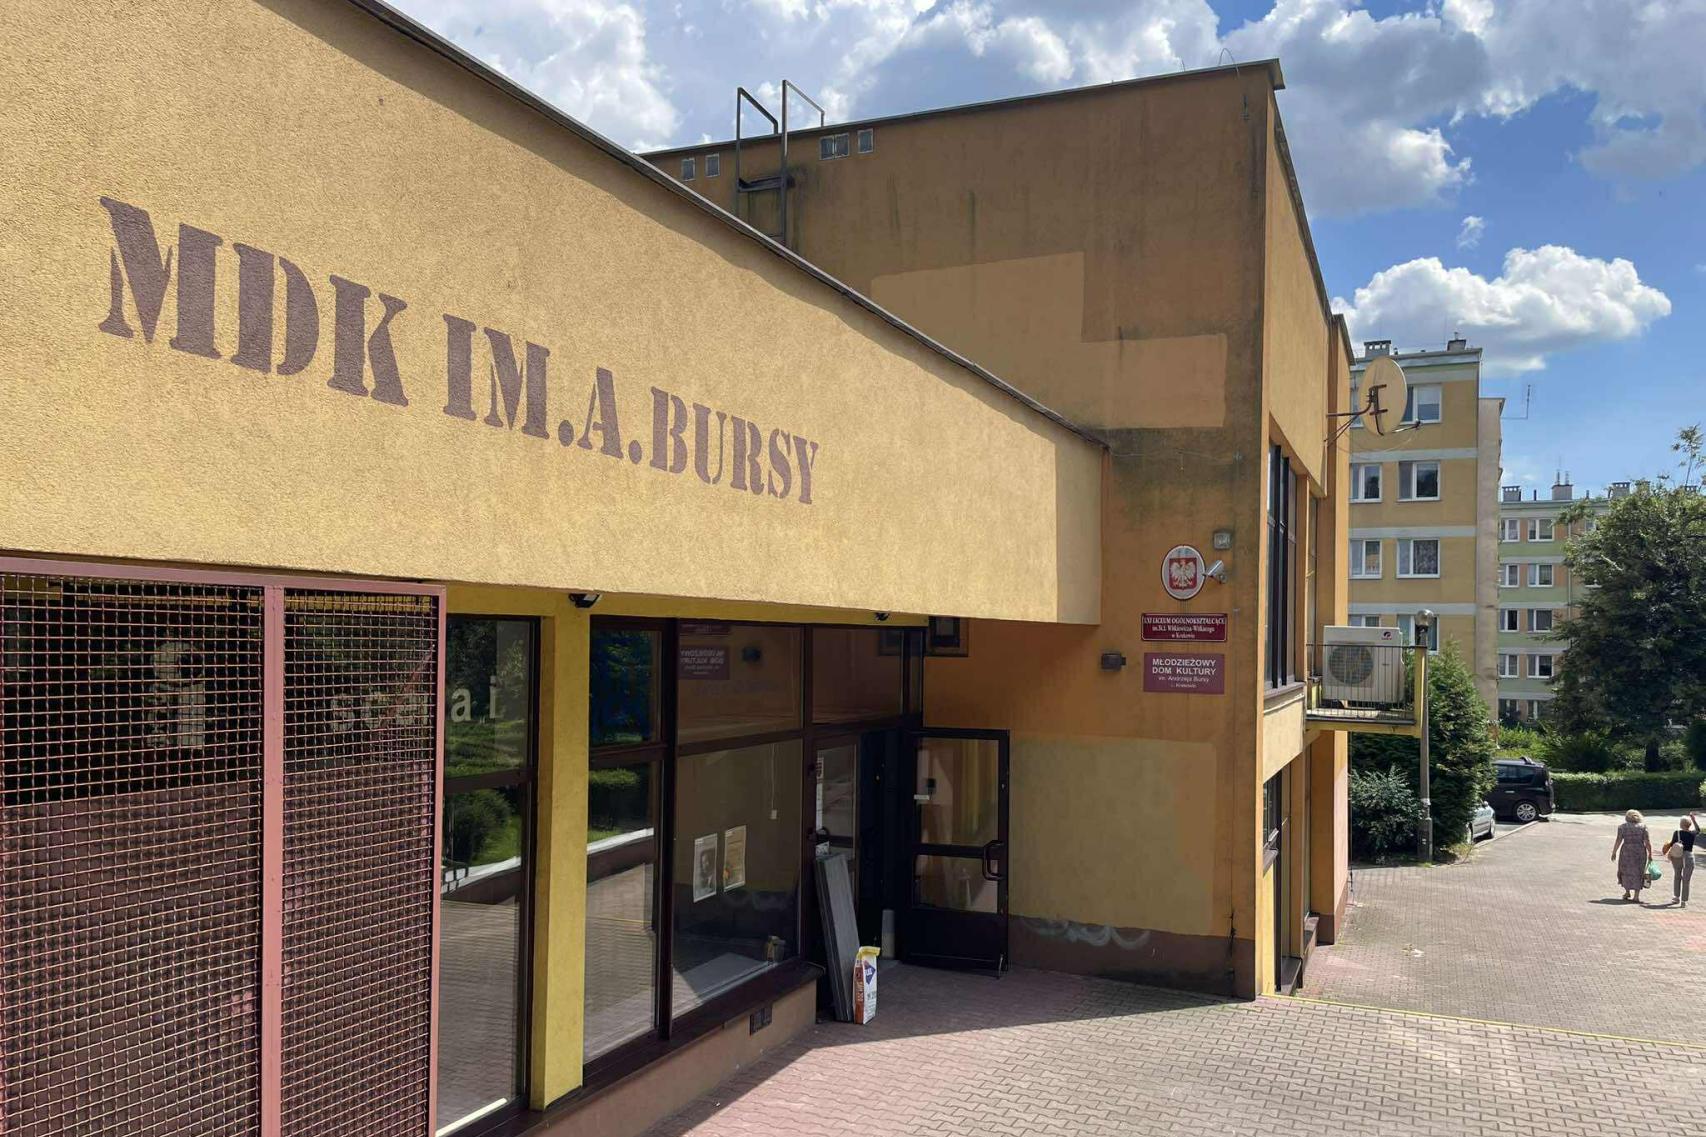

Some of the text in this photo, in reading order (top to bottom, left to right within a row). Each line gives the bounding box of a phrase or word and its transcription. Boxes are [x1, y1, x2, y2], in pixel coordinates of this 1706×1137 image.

[98, 195, 409, 407] MDK
[1152, 657, 1216, 667] MŁODZIEŻOWY
[1152, 666, 1217, 675] DOM KULTURY
